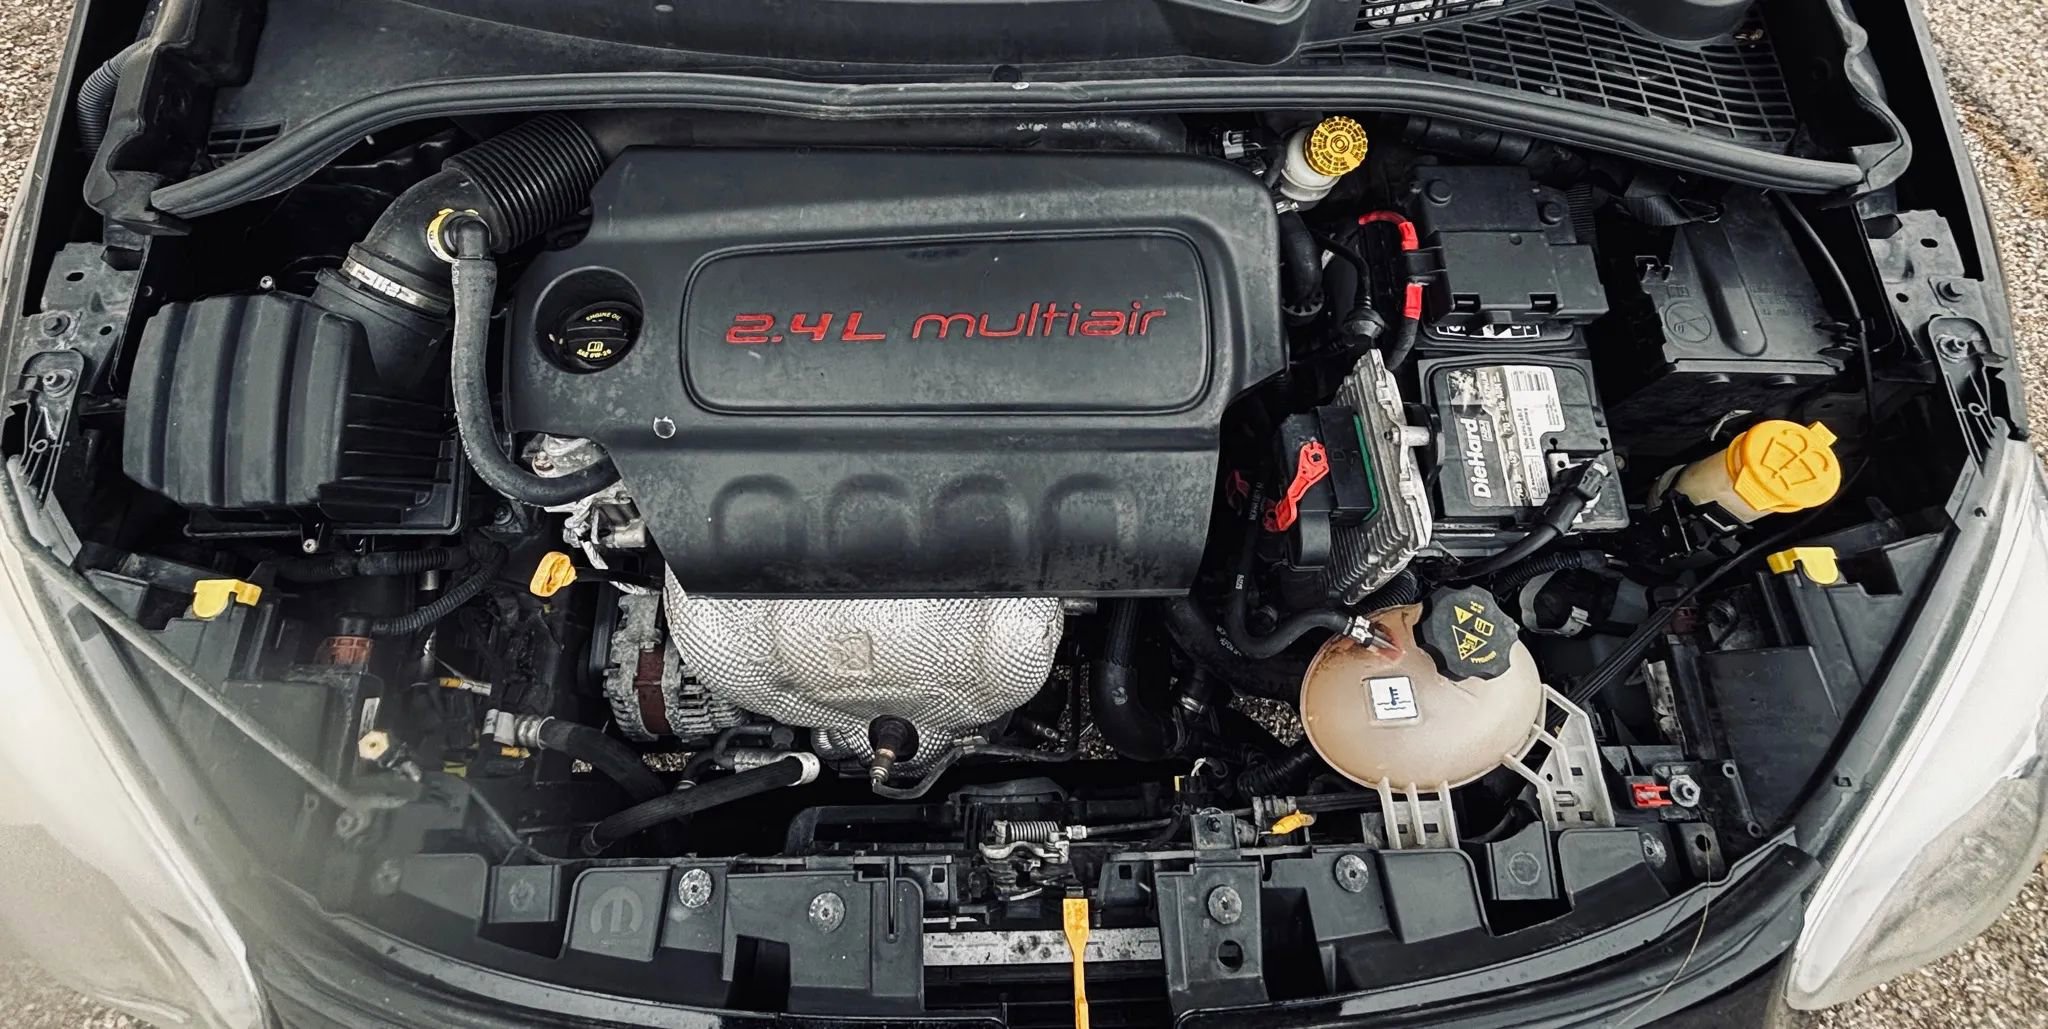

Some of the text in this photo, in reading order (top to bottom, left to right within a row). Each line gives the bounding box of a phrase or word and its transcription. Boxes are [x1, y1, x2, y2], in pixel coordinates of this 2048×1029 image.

[585, 312, 622, 321] ENGINE OIL
[912, 301, 1167, 339] multiair
[576, 348, 589, 358] SAE
[1460, 417, 1492, 498] DieHard
